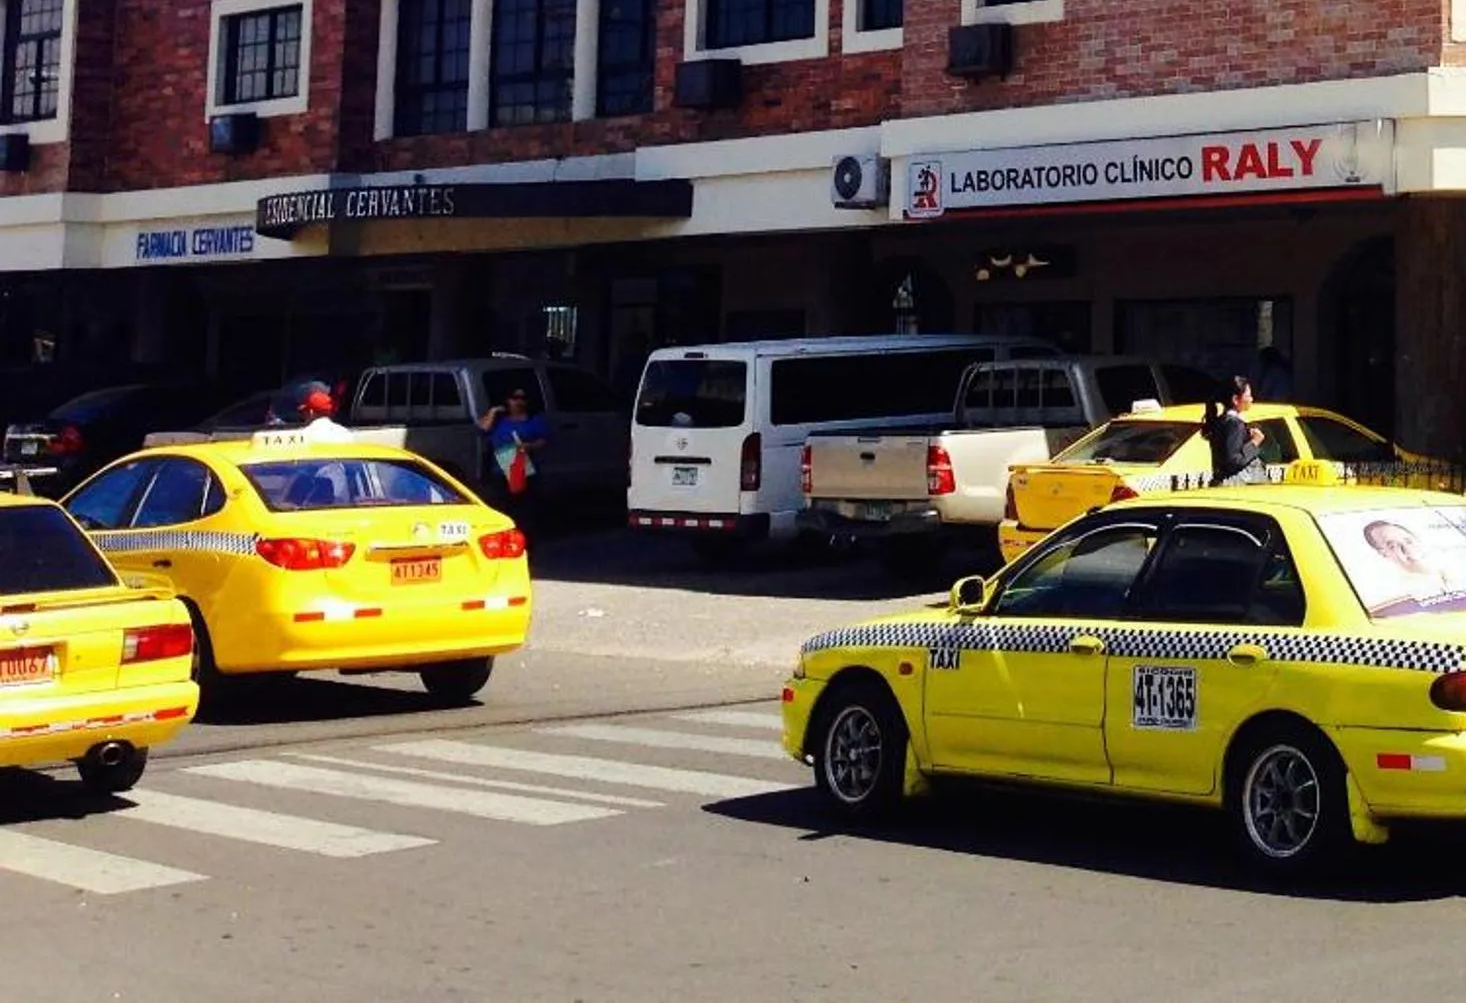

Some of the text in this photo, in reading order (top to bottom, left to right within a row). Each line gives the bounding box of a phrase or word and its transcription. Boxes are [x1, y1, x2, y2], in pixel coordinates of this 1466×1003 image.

[950, 139, 1323, 194] LABORATORIO CLÍNICO RALY
[345, 188, 456, 217] CERVANTES
[192, 226, 254, 255] CERVANTES
[262, 435, 305, 447] TAXI
[1292, 463, 1319, 480] TAXI
[929, 648, 960, 671] TAXI
[1135, 674, 1195, 719] 4T-1365
